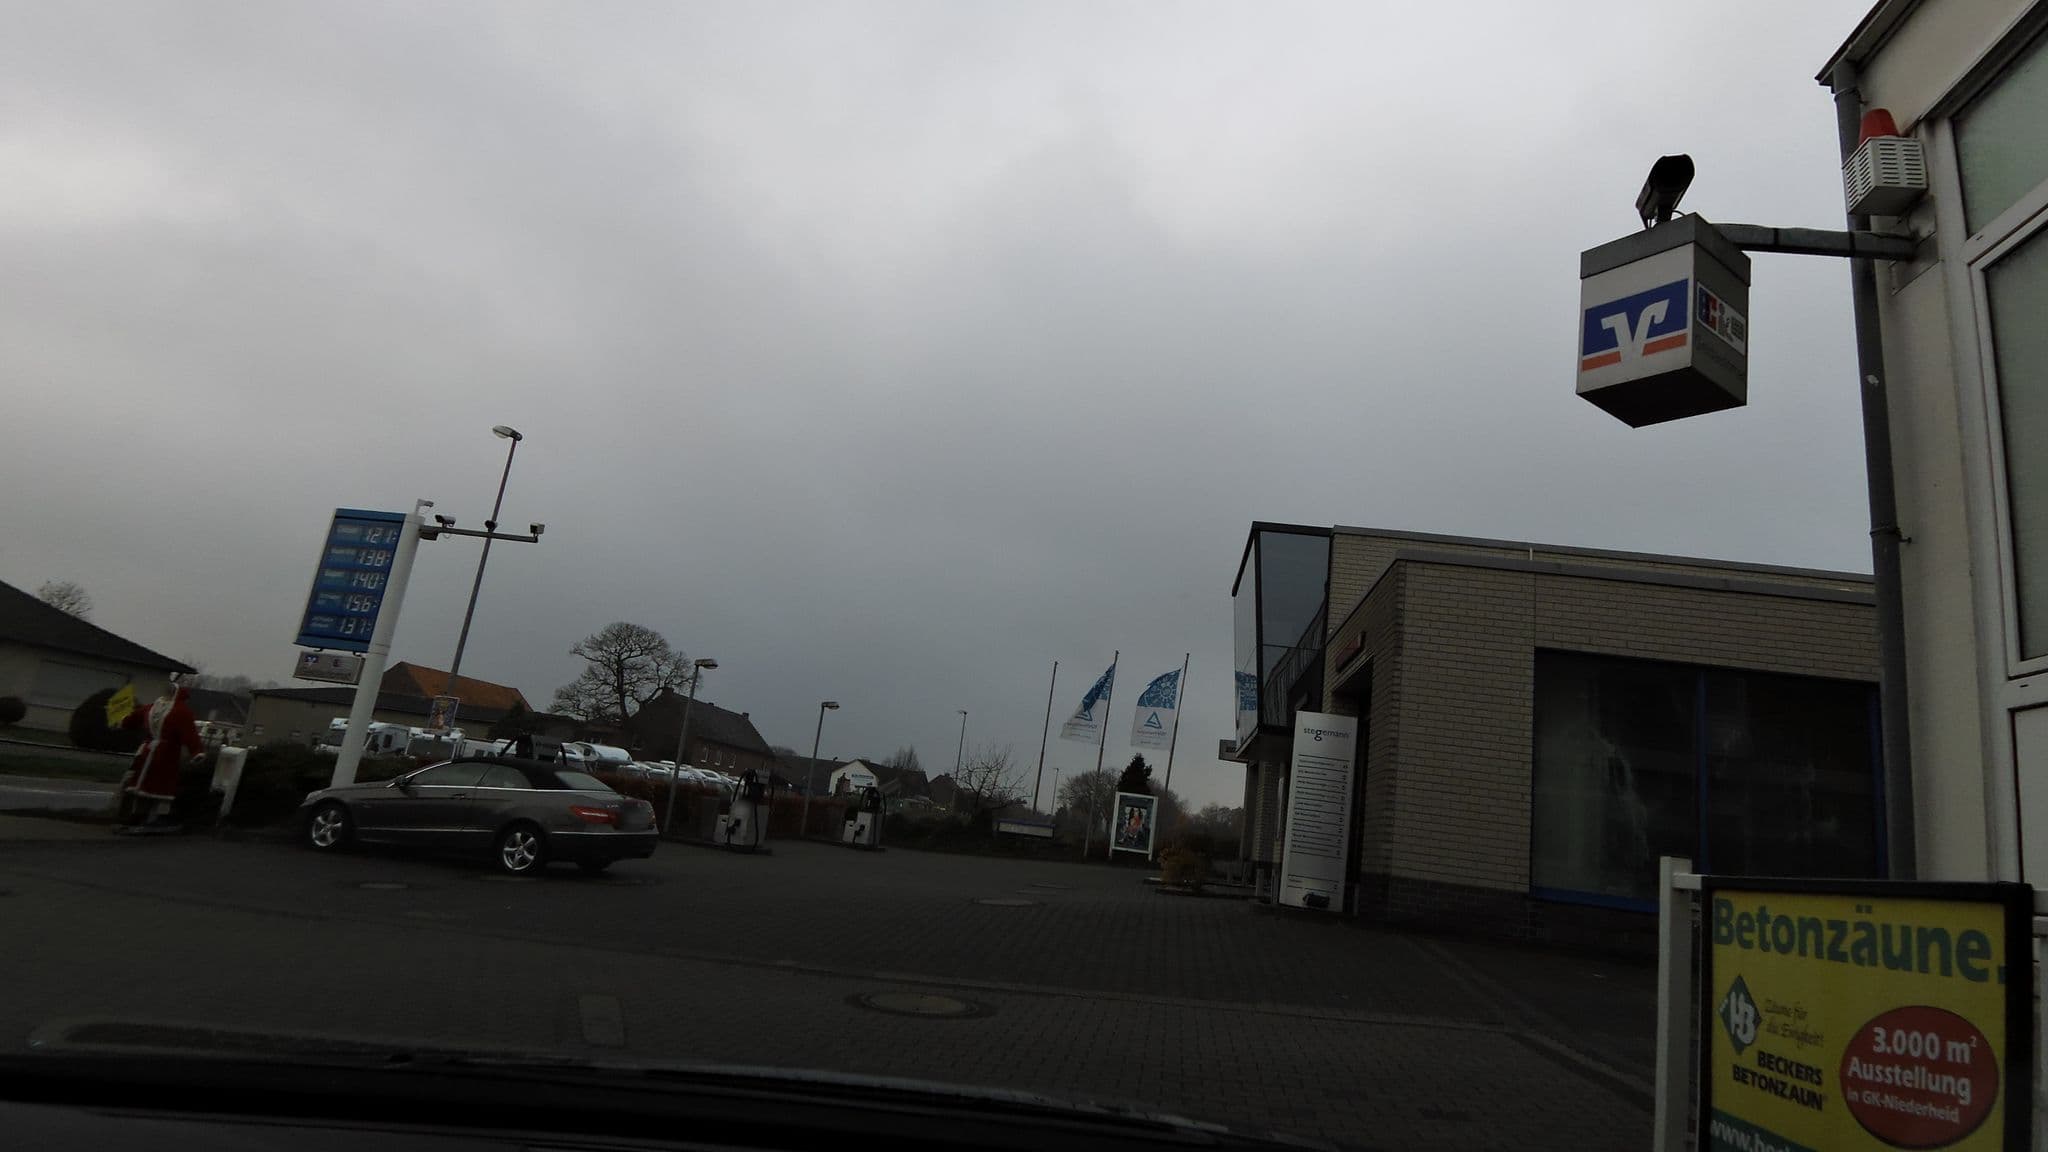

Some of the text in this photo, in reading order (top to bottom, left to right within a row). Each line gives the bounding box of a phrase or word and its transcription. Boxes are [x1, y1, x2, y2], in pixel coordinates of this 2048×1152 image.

[1712, 898, 2006, 984] Betonzäune.
[1872, 1026, 1941, 1061] 3.000
[1732, 1064, 1823, 1112] BETONZAUN
[1757, 1050, 1823, 1087] BECKERS
[1847, 1056, 1972, 1105] Ausstellung
